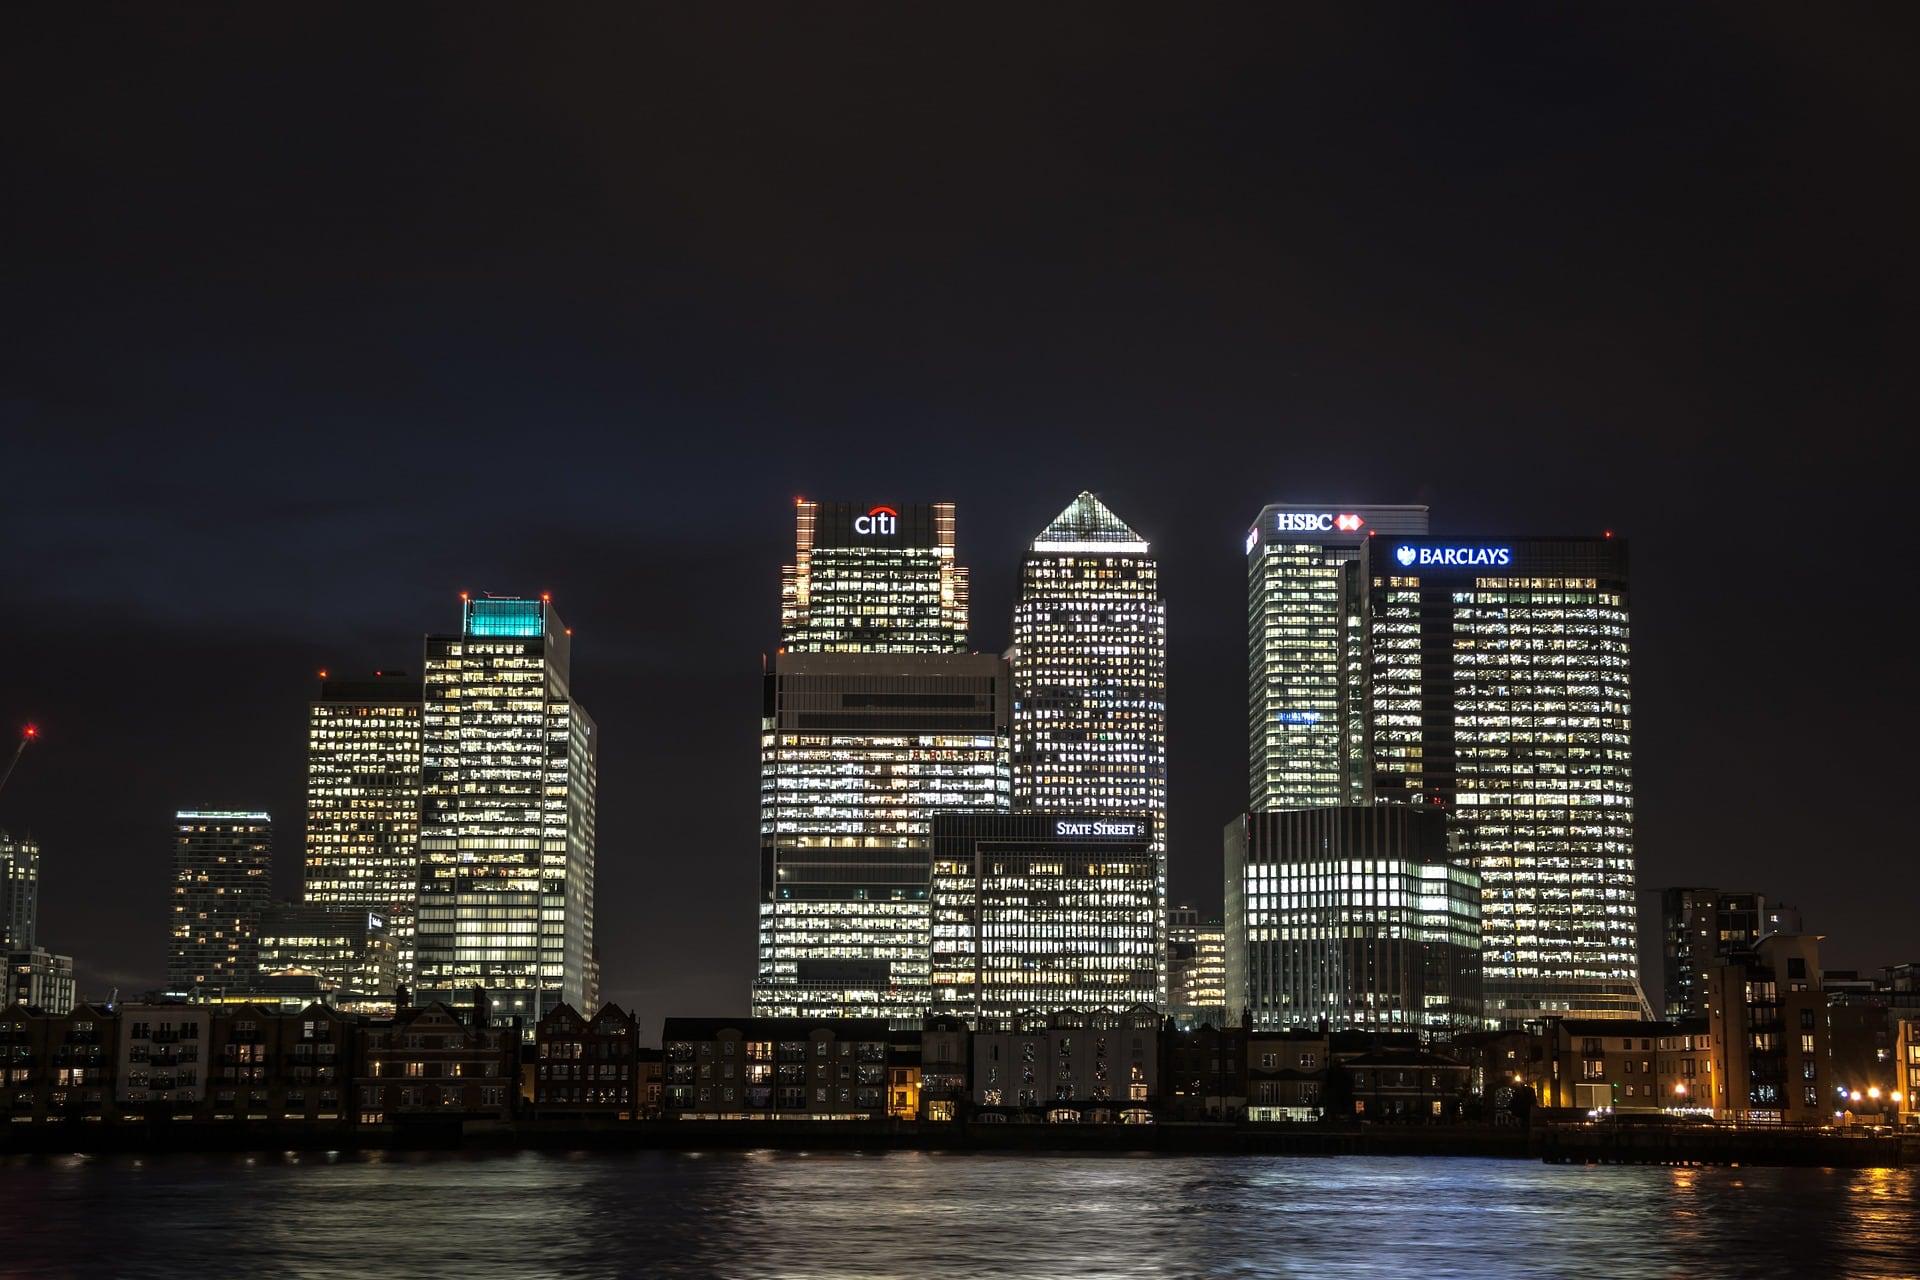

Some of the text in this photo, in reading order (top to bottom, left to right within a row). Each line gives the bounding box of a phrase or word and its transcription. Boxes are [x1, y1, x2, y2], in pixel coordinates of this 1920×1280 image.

[855, 511, 896, 535] citi
[1278, 513, 1333, 531] HSBC
[1419, 547, 1509, 565] BARCLAYS
[1056, 822, 1136, 835] STATE STREET
